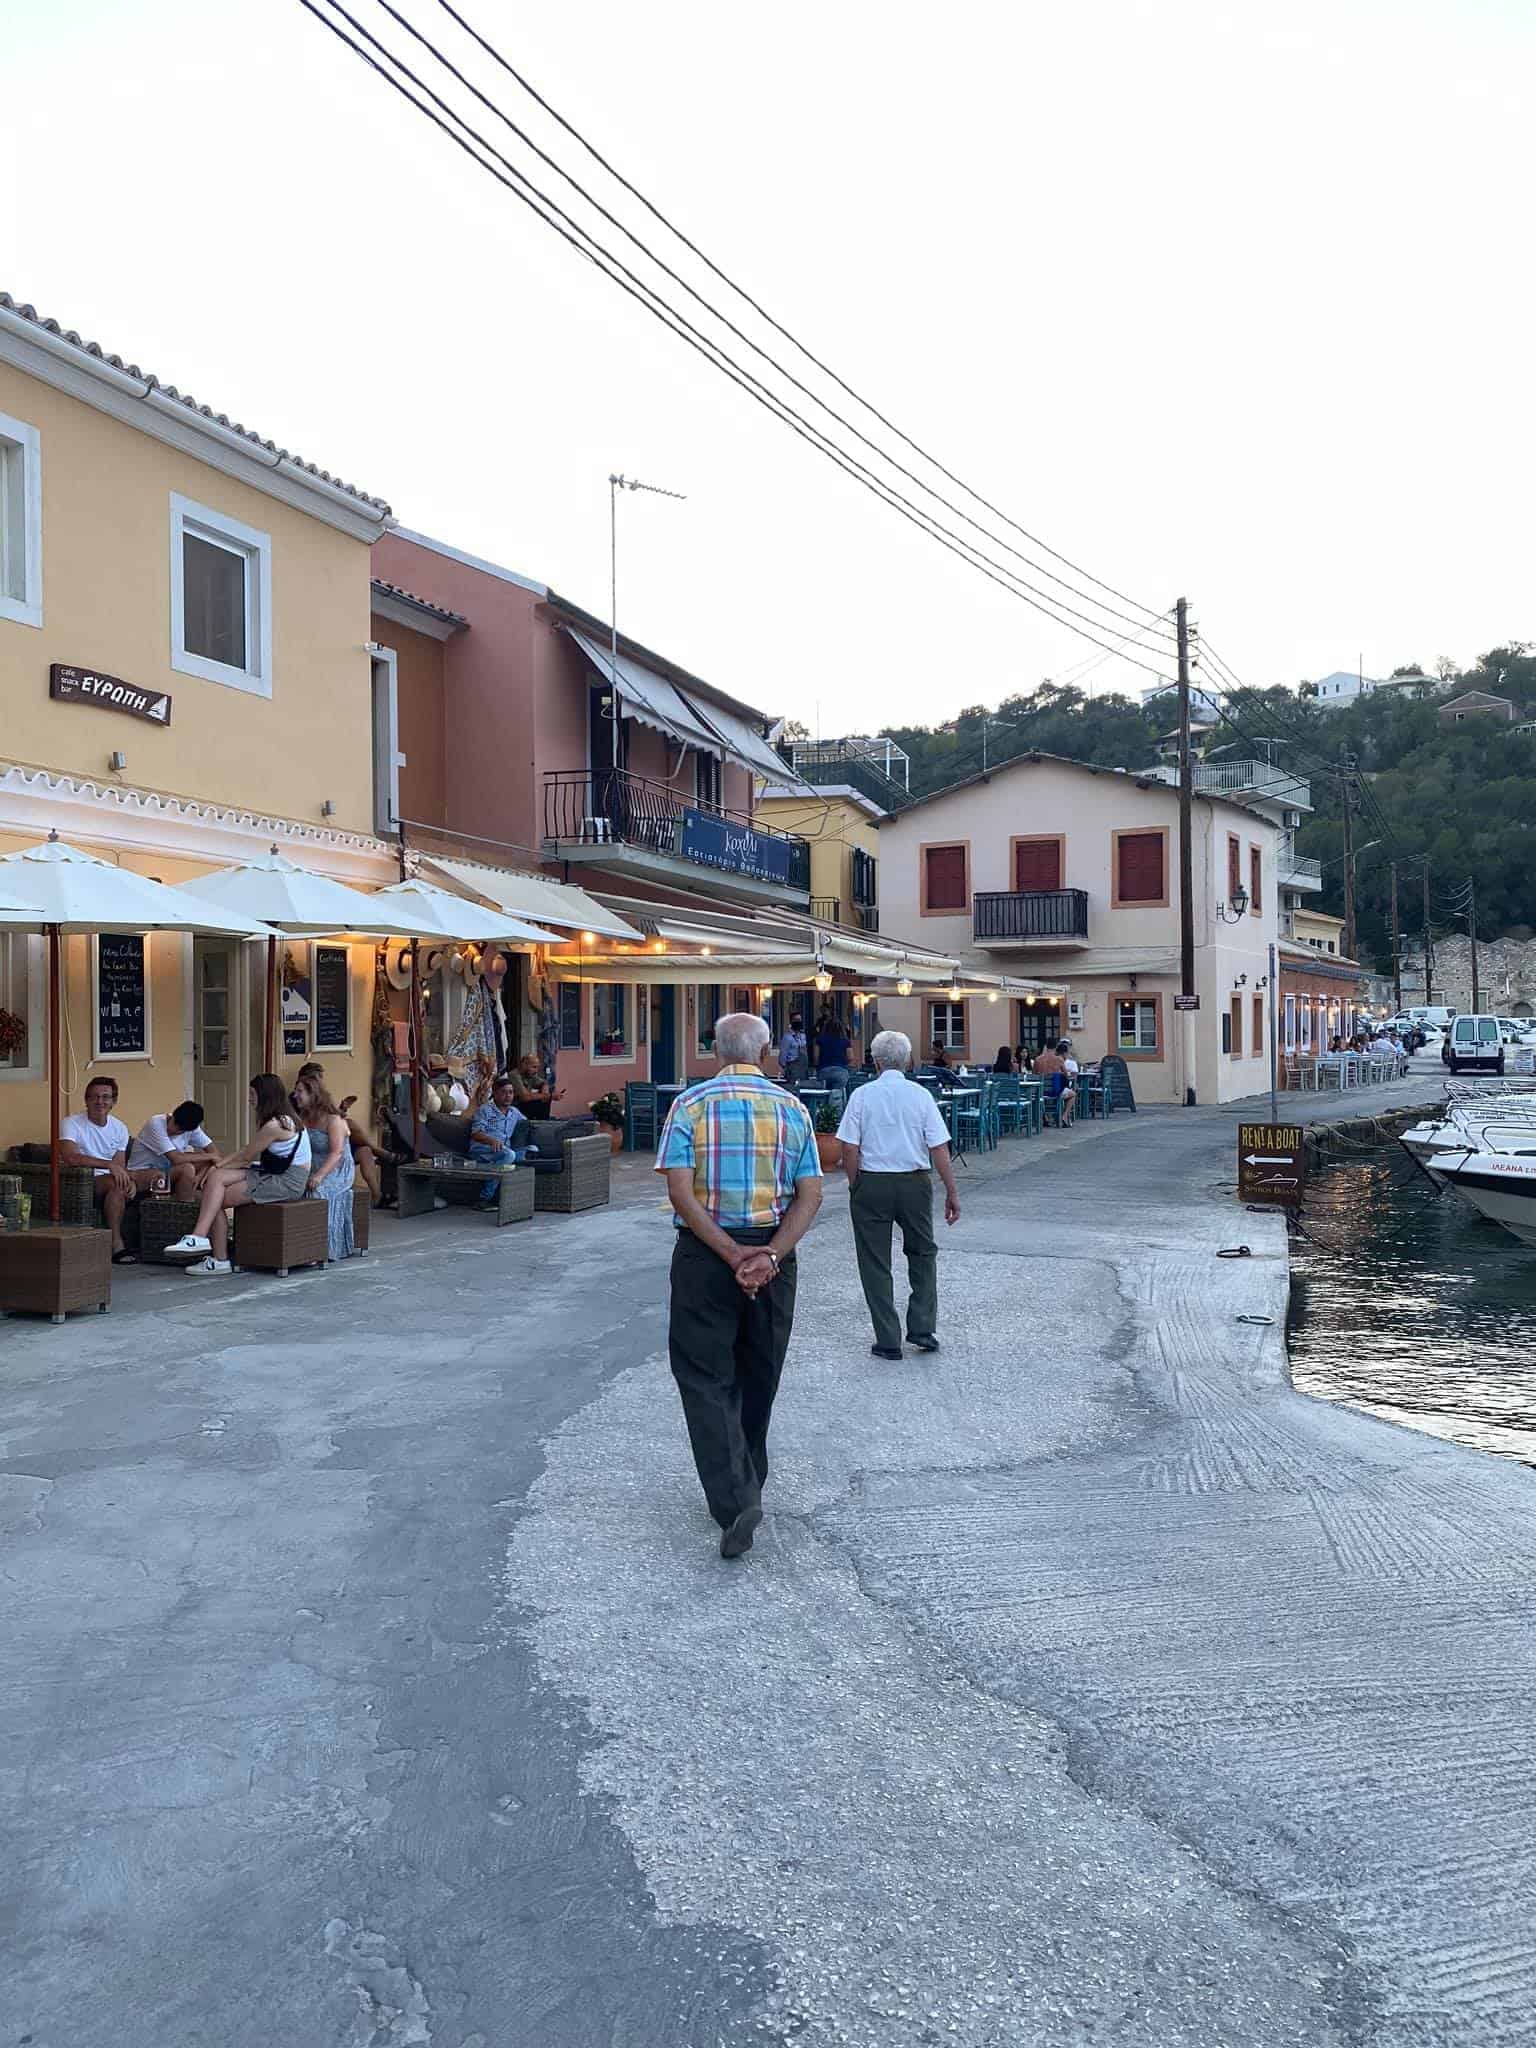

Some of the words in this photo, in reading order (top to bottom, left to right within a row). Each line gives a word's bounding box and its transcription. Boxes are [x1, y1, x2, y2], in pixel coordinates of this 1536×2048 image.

[81, 676, 148, 710] ΕΥΡΩΠΗ
[1241, 1126, 1265, 1149] RENT
[1267, 1128, 1274, 1149] A
[1276, 1128, 1300, 1150] BOAT
